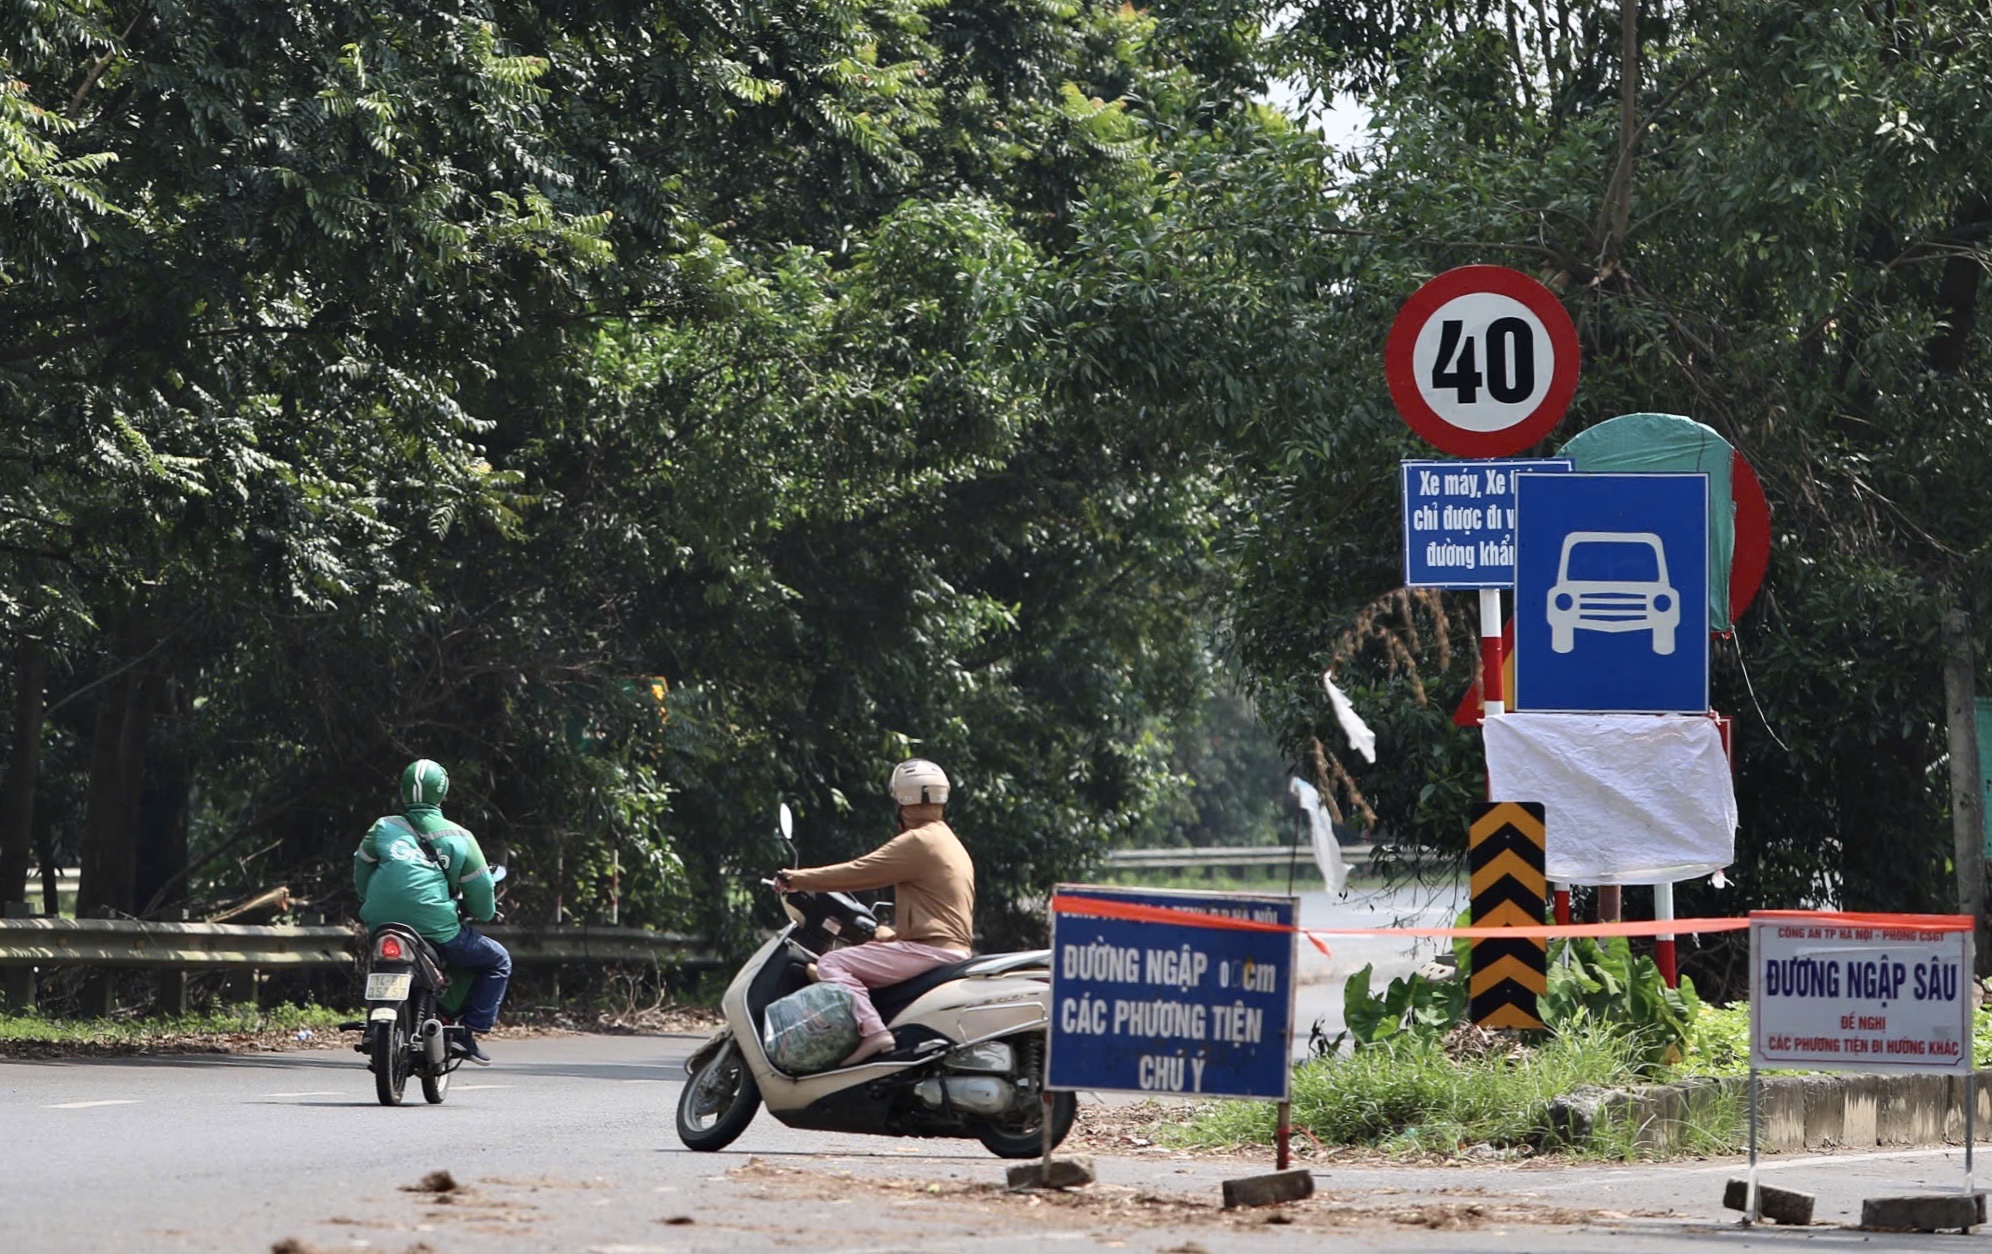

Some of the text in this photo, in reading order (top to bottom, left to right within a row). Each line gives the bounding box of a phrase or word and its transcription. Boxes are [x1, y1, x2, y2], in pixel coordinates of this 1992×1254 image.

[1432, 317, 1535, 404] 40
[1419, 471, 1440, 496] Xe
[1485, 469, 1506, 495] Xe
[1413, 502, 1439, 531] chỉ
[1443, 504, 1482, 535] được
[1426, 538, 1476, 570] đường
[1825, 928, 1837, 940] TP
[1063, 935, 1140, 983] ĐƯỜNG
[1146, 944, 1208, 993] NGẬP
[1847, 954, 1906, 1008] NGẬP
[1914, 955, 1958, 1001] SÂU
[1061, 992, 1263, 1048] CÁC PHƯƠNG TIỆN
[1768, 1033, 1791, 1051] CÁC
[1844, 1036, 1868, 1056] TIỆN
[1872, 1039, 1883, 1053] ĐI
[1929, 1038, 1959, 1056] KHÁC
[1139, 1049, 1207, 1093] CHÚ Ý
